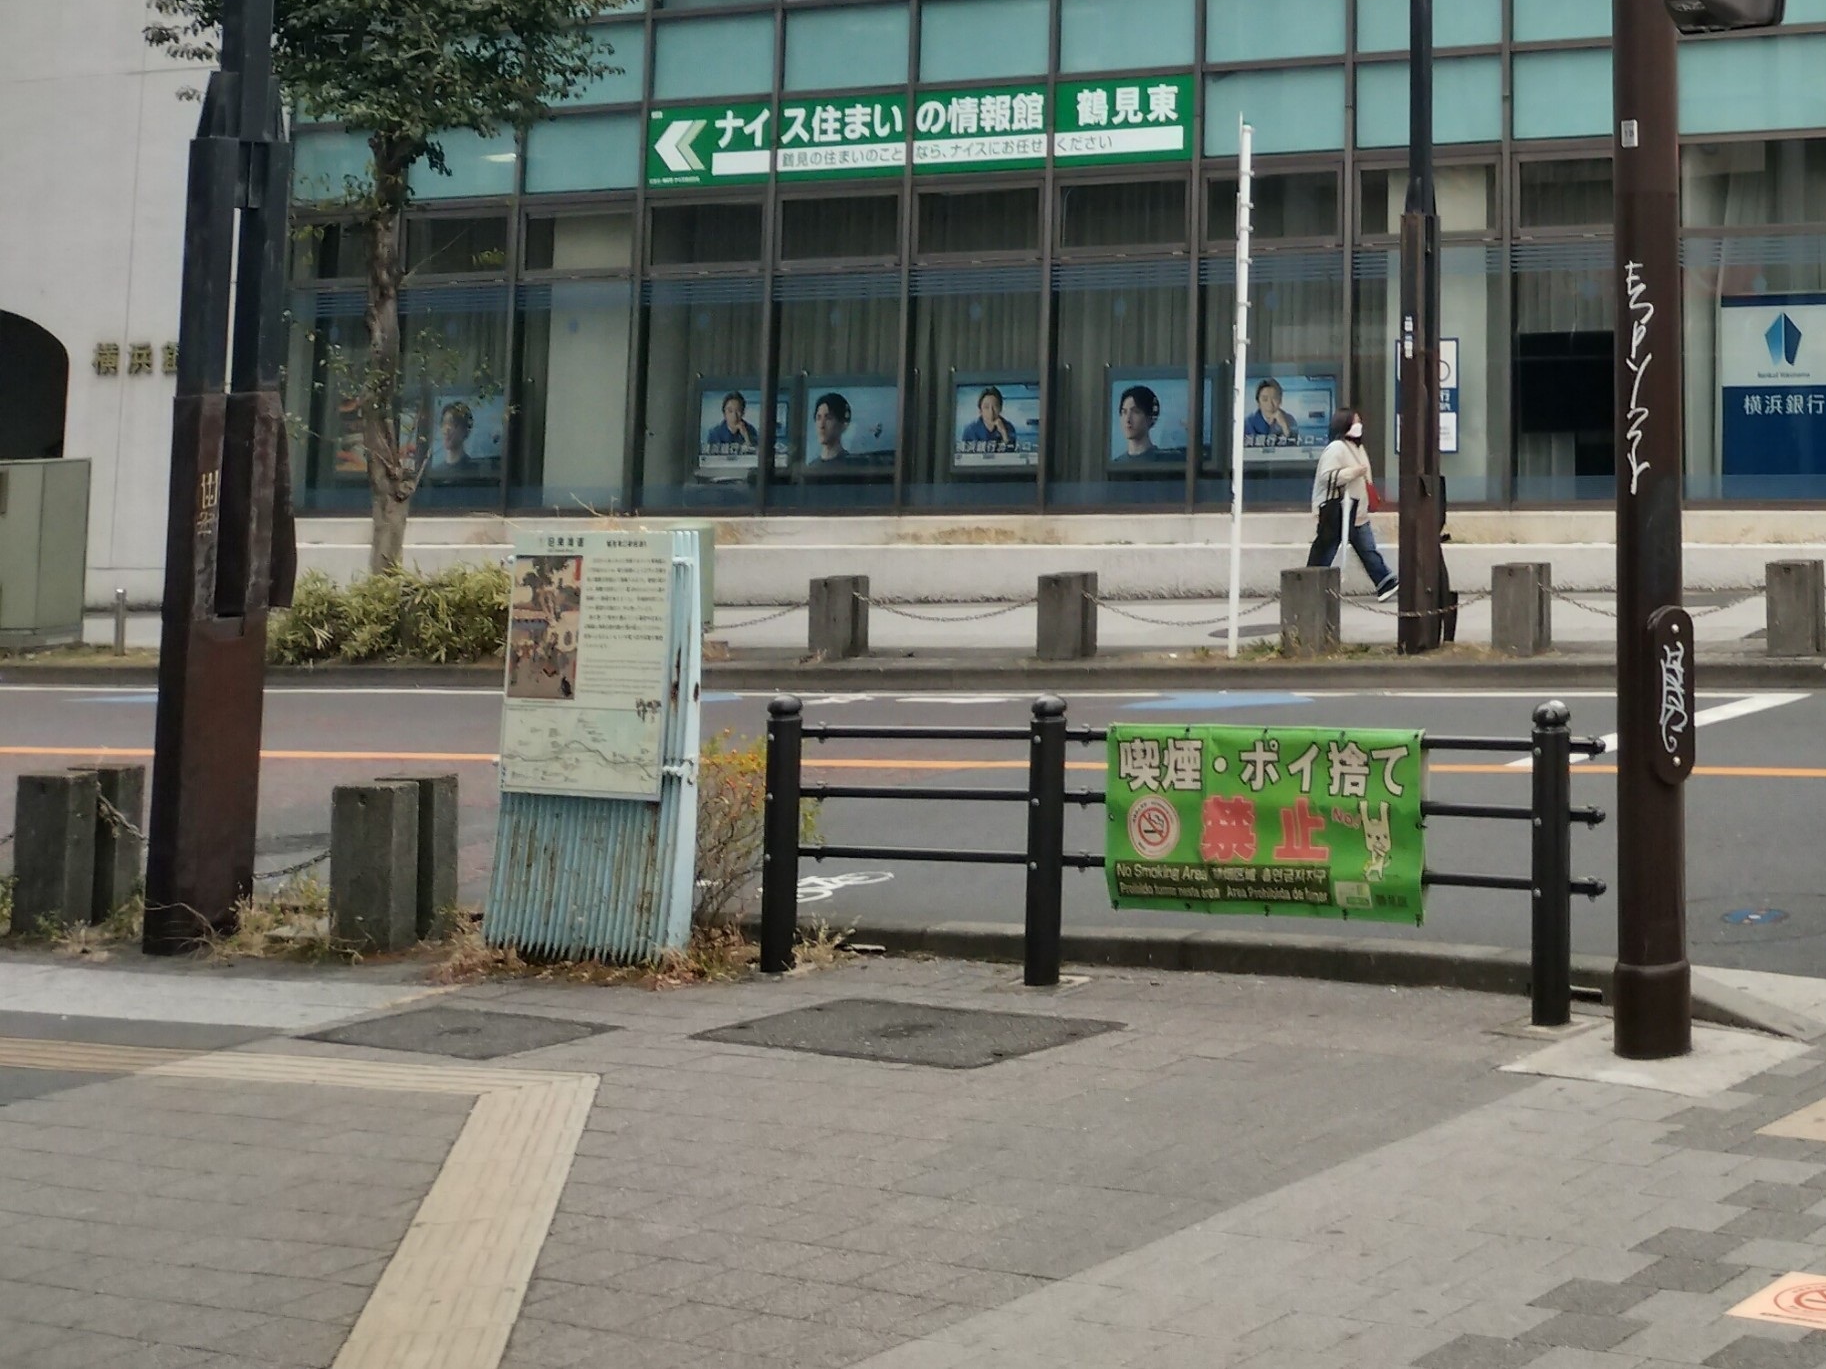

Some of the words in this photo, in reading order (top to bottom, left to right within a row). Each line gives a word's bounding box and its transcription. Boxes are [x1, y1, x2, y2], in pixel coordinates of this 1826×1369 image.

[714, 92, 1044, 149] ナイス住まいの情報館
[1076, 84, 1180, 126] 鶴見東
[782, 134, 1113, 168] 鶴見の住まいのことなら、ナイスにお任せください
[1743, 394, 1826, 415] 横浜銀行
[1119, 737, 1409, 798] 喫煙・ポイ捨て
[1201, 795, 1331, 862] 禁止
[1117, 862, 1132, 877] No
[1134, 863, 1180, 882] Smoking
[1181, 865, 1208, 882] Area
